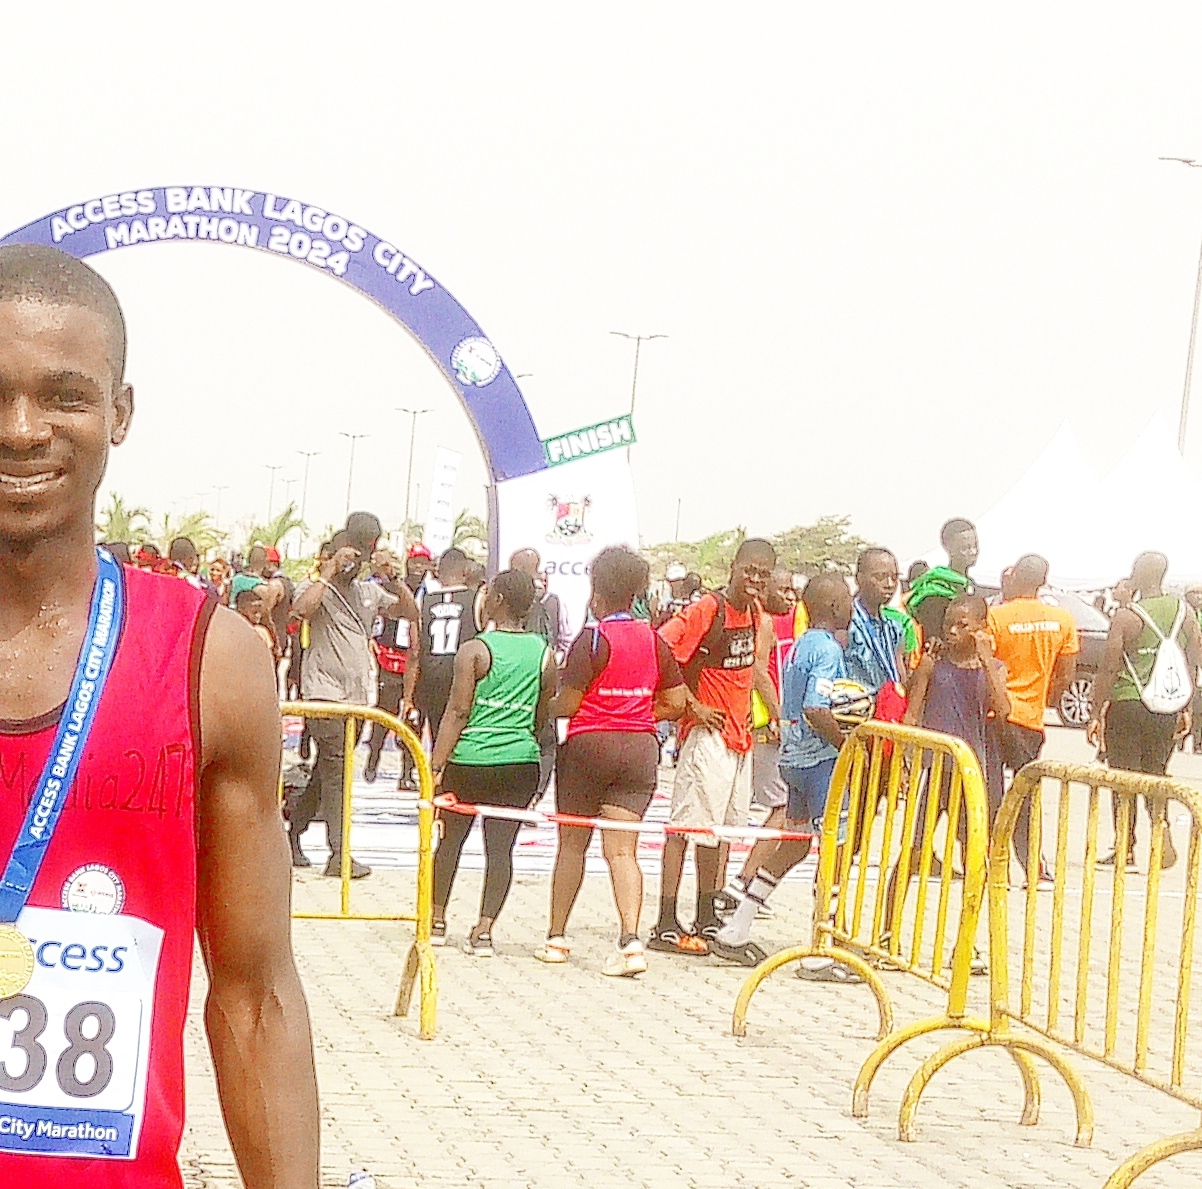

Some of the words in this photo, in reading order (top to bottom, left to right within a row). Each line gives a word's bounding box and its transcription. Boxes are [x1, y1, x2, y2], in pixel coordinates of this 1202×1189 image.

[50, 190, 156, 243] ACCESS
[164, 186, 255, 216] BANK
[262, 193, 369, 254] LAGOS
[371, 240, 435, 297] CITY
[105, 214, 261, 251] MARATHON
[266, 225, 351, 278] 2024
[547, 418, 633, 463] FINISH
[544, 561, 592, 576] acce
[91, 578, 116, 647] MARATHON
[430, 619, 460, 655] 11
[84, 645, 105, 680] CITY
[67, 678, 96, 731] LAGOS
[52, 730, 79, 777] BANK
[30, 779, 61, 840] ACCESS
[85, 863, 109, 873] LAGOS
[106, 869, 120, 885] CITY
[27, 937, 128, 973] cess
[37, 1120, 118, 1142] Marathon
